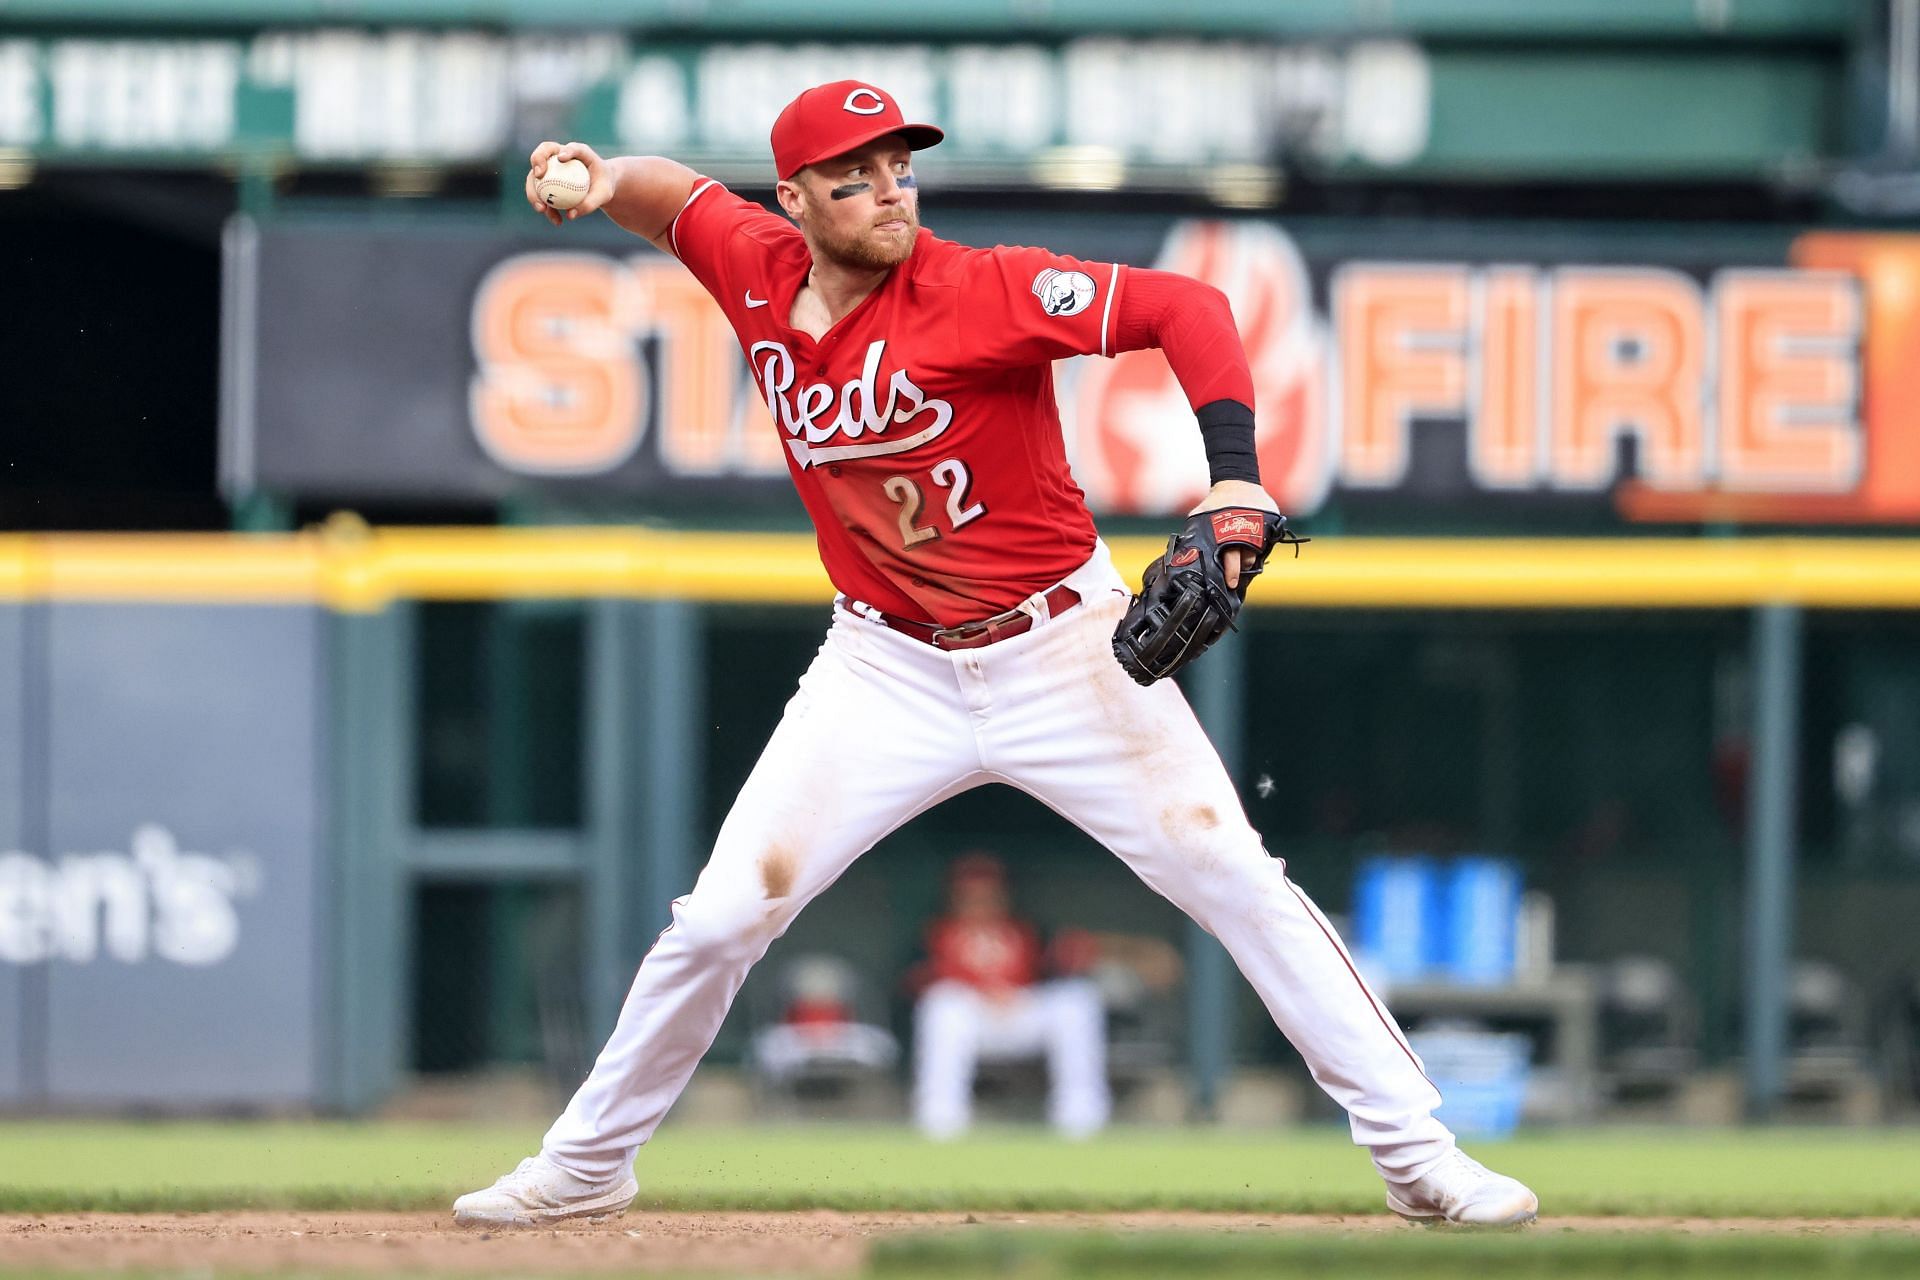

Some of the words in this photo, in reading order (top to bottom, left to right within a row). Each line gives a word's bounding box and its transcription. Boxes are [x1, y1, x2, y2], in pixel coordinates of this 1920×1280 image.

[843, 88, 885, 115] C
[751, 340, 953, 471] Reds
[1330, 261, 1867, 494] FIRE
[882, 457, 987, 551] 22
[1218, 516, 1261, 535] Rawlings
